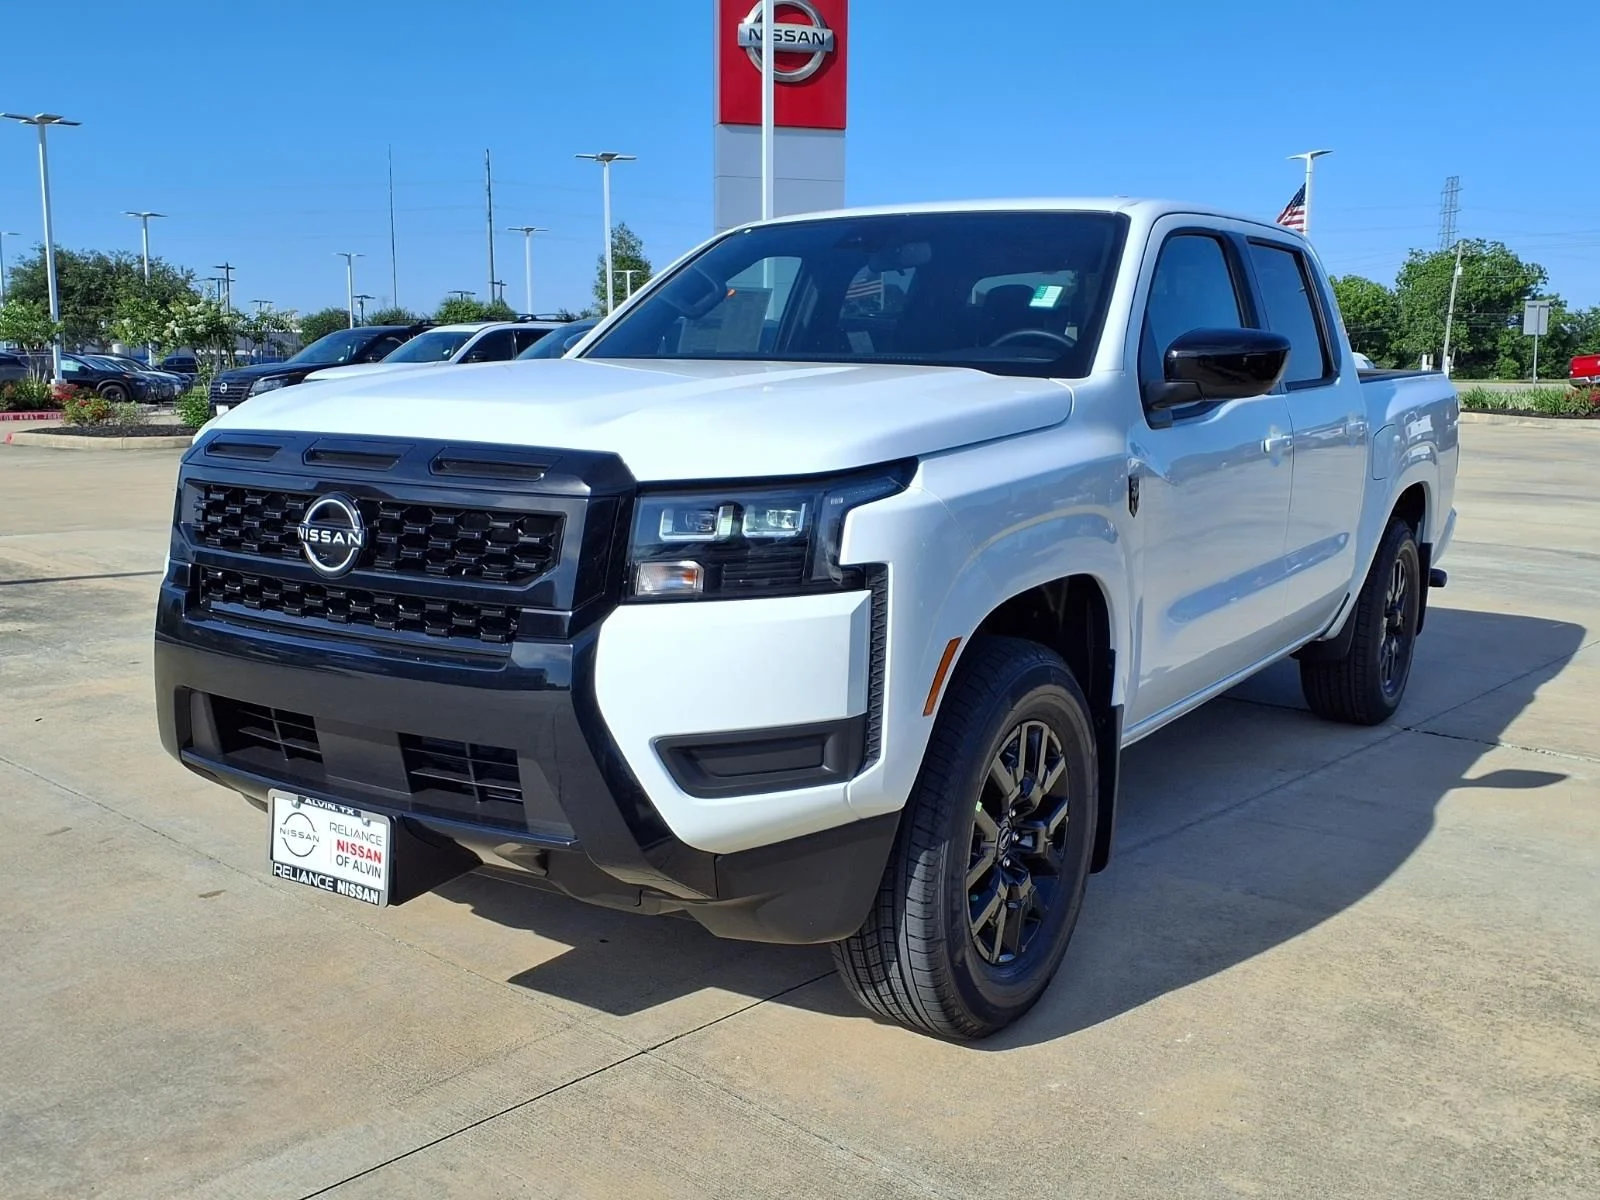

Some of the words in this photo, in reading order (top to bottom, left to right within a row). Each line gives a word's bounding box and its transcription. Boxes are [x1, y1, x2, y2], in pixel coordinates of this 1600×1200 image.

[748, 28, 825, 46] NSSAN
[297, 526, 362, 545] NISSAN
[340, 805, 355, 816] TX
[279, 826, 320, 843] NISSAN
[329, 821, 383, 847] RELIANCE
[336, 839, 382, 864] NISSAN
[336, 854, 351, 868] OF
[352, 860, 382, 879] ALVIN
[273, 864, 334, 891] RELIANCE
[336, 879, 379, 904] NISSAN
